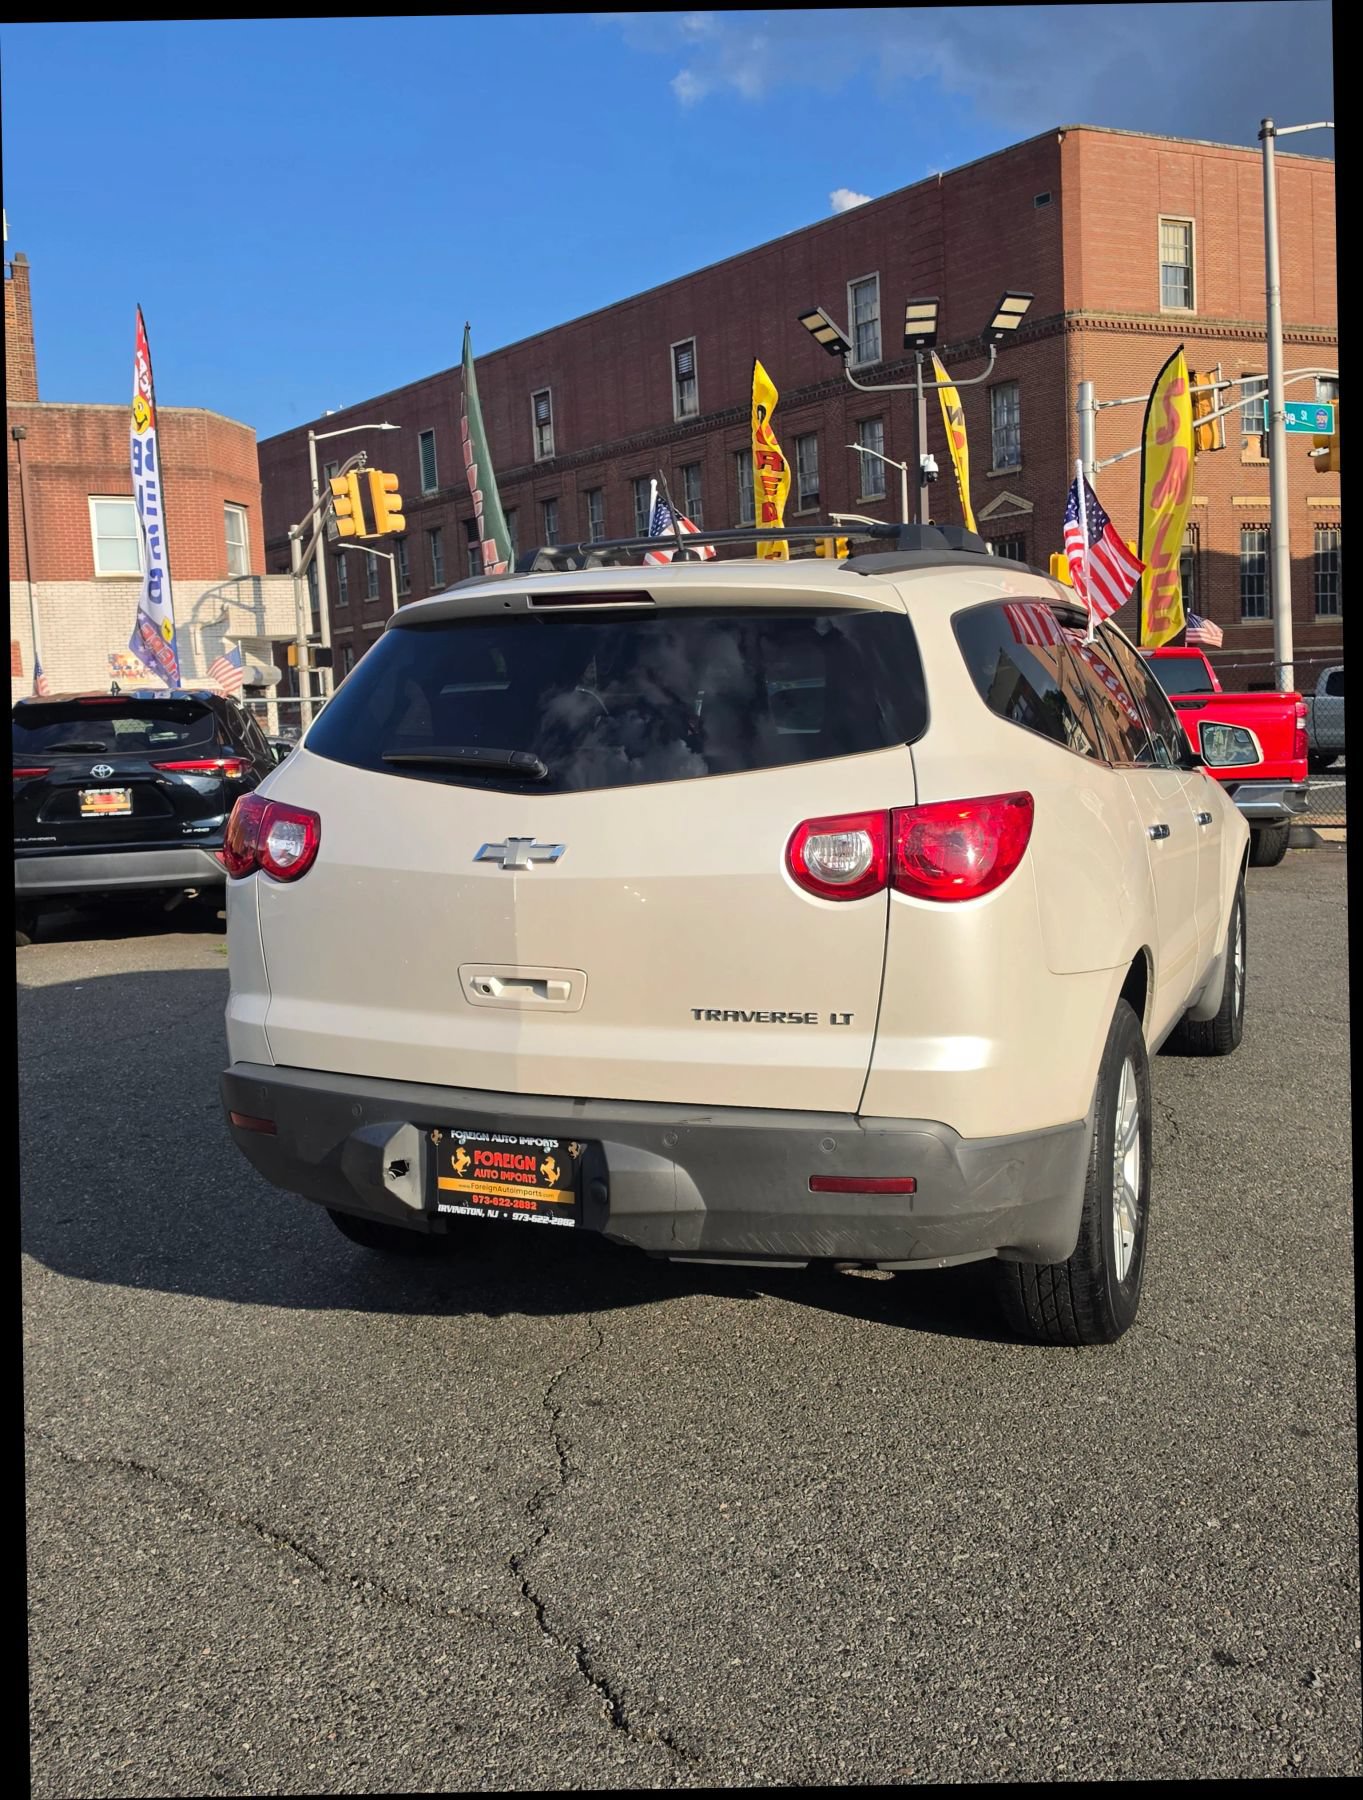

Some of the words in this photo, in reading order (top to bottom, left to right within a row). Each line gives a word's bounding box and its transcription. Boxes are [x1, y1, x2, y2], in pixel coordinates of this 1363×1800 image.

[691, 1008, 819, 1025] TRAVERSE
[829, 1012, 854, 1026] LT
[450, 1129, 490, 1143] FOREIGN
[490, 1133, 518, 1145] AUTO
[519, 1136, 559, 1149] IMPORTS
[473, 1149, 537, 1172] FOREIGN
[473, 1168, 499, 1180] AUTO
[500, 1170, 537, 1184] IMPORTS
[472, 1194, 538, 1211] 973-622-2882
[437, 1203, 486, 1218] IRVINGTON,
[487, 1209, 500, 1219] NJ
[511, 1211, 576, 1228] 973-622-2882
